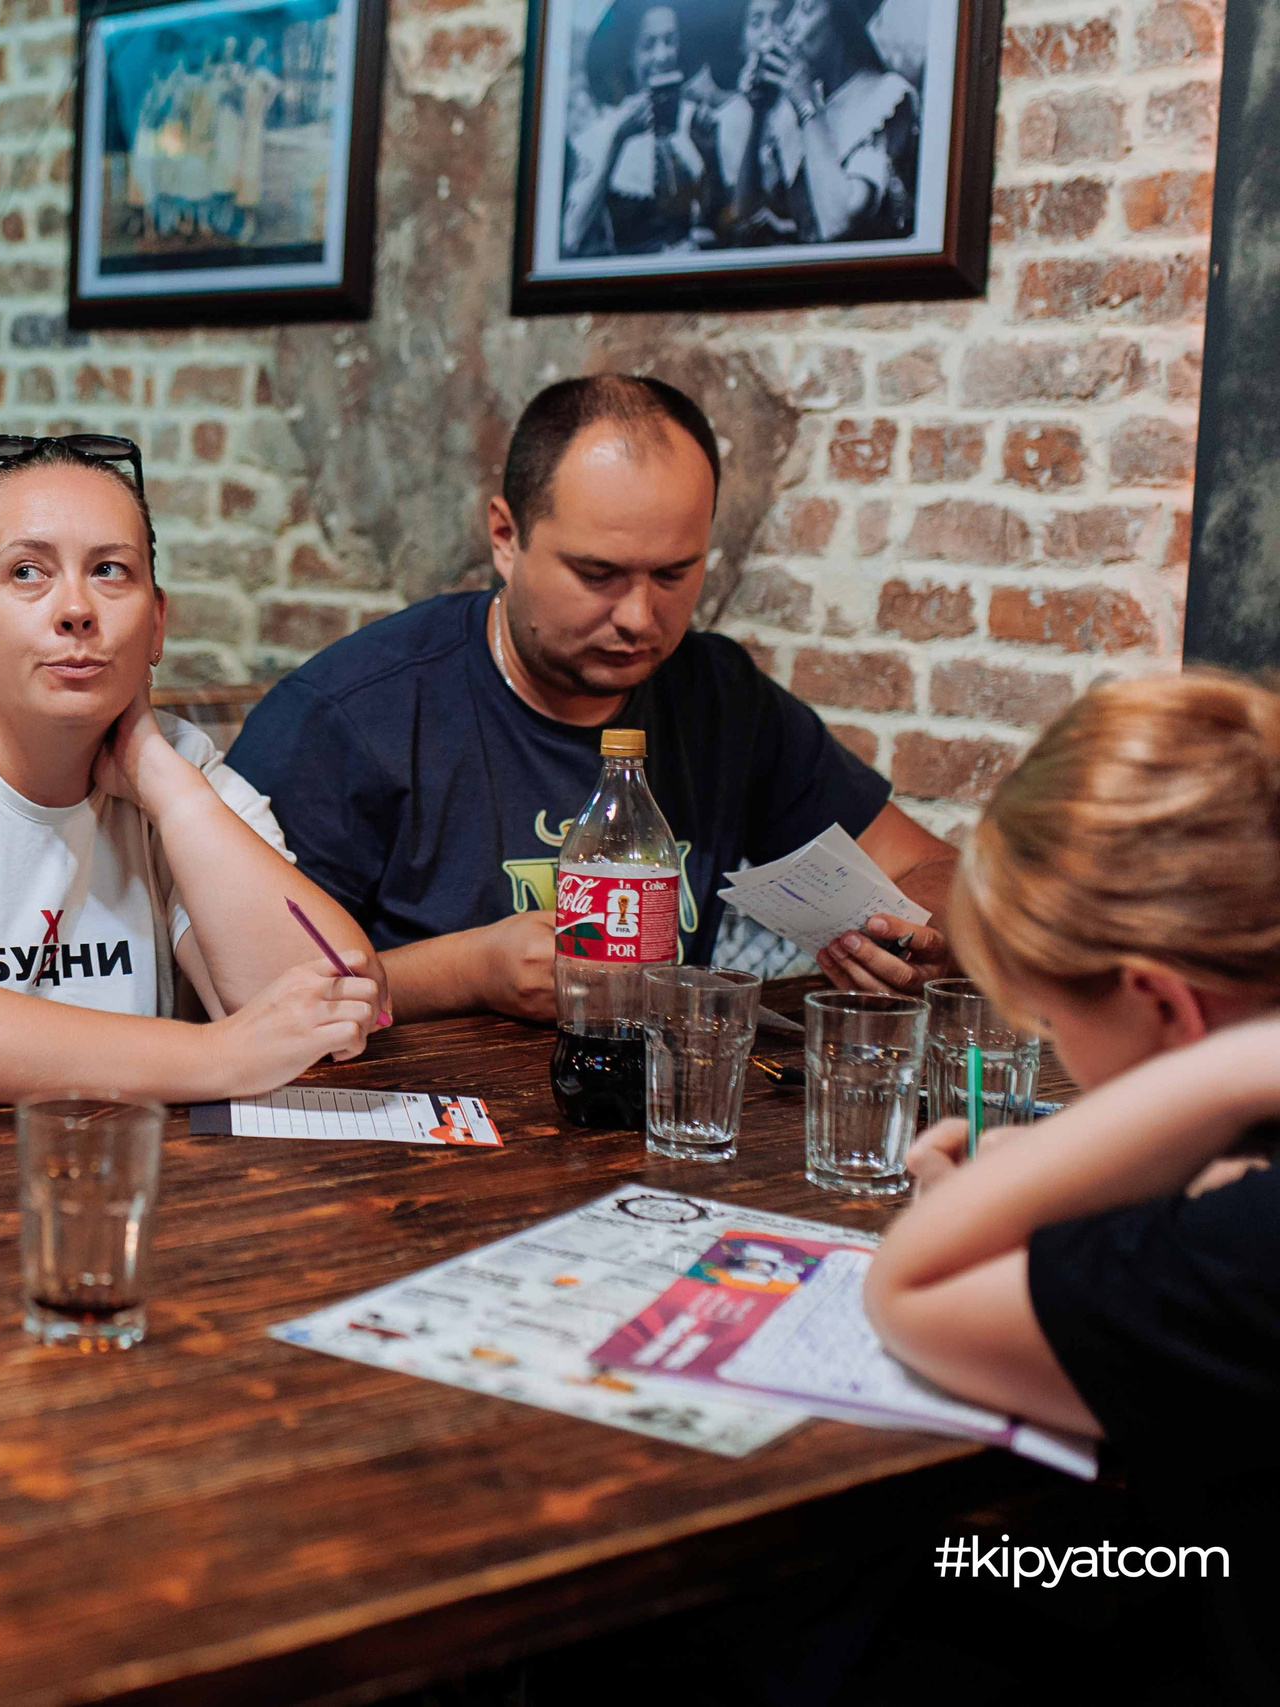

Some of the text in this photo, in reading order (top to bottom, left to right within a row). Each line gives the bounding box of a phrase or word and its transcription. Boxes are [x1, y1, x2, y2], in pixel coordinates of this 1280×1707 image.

[642, 880, 667, 891] Coke
[557, 875, 601, 914] Cola
[607, 944, 636, 958] POR
